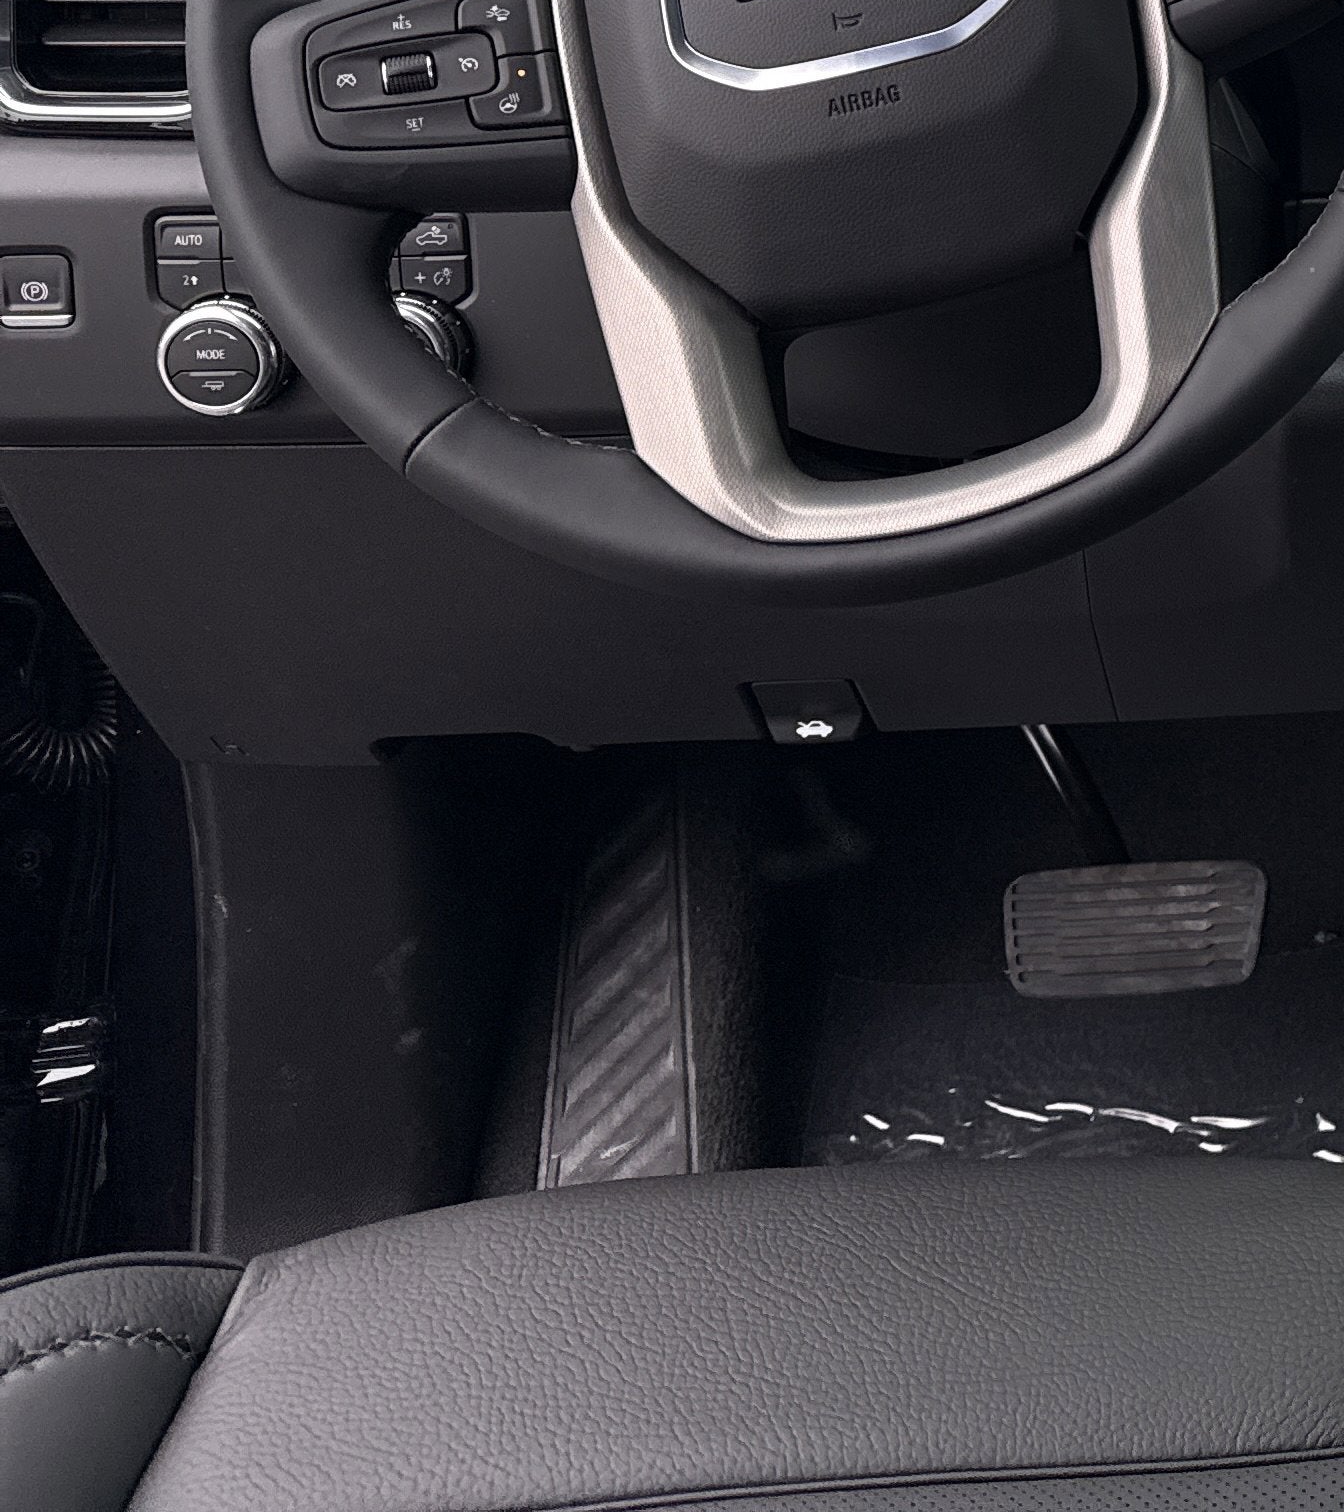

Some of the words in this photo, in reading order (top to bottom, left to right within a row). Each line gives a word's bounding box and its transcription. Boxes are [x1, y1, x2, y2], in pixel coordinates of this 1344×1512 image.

[392, 20, 412, 31] RES
[828, 84, 901, 117] AIRBAG
[405, 117, 424, 129] SET
[174, 234, 203, 246] AUTO
[196, 349, 226, 360] MODE
